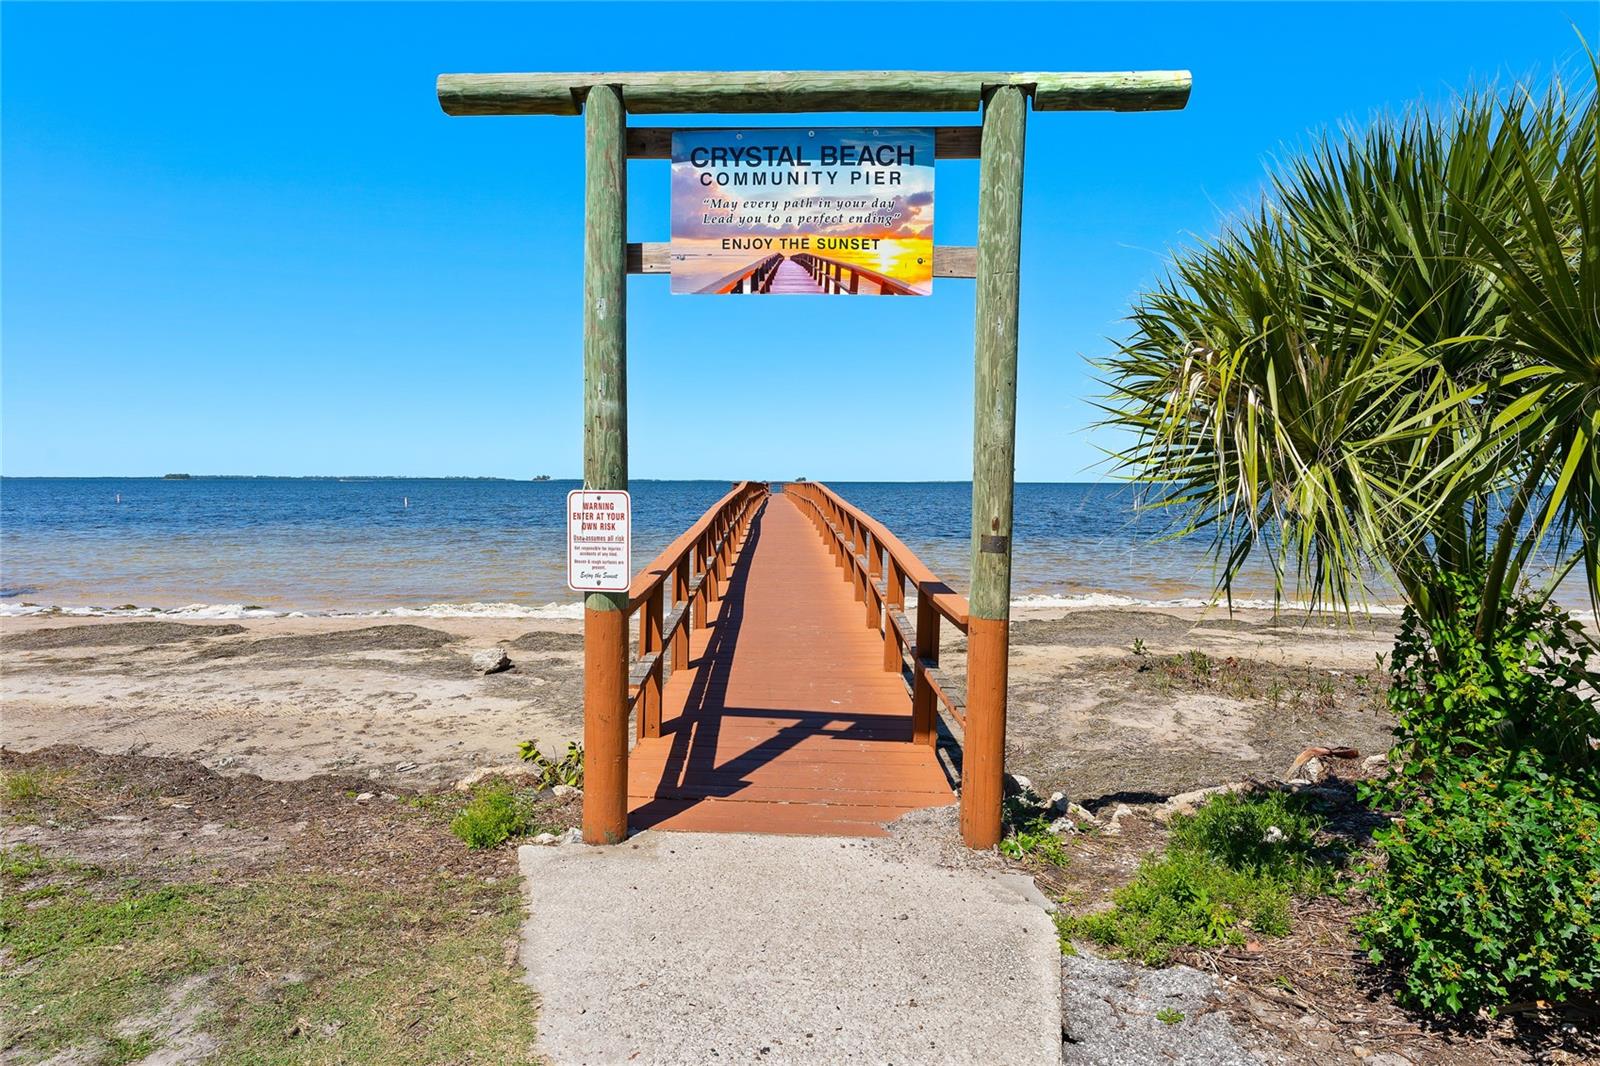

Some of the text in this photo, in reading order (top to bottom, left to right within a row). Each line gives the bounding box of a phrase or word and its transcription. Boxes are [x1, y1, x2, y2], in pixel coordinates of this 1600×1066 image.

[690, 145, 915, 168] CRYSTAL BEACH
[700, 171, 902, 187] COMMUNITY PIER
[703, 197, 895, 212] “May every path in your day
[703, 213, 902, 227] Lead you to a perfect ending”
[721, 238, 881, 250] ENJOY THE SUNSET
[583, 502, 615, 511] WARNING
[572, 512, 625, 521] ENTER AT YOUR
[582, 522, 616, 531] OWN RISK
[580, 571, 594, 579] Enjoy
